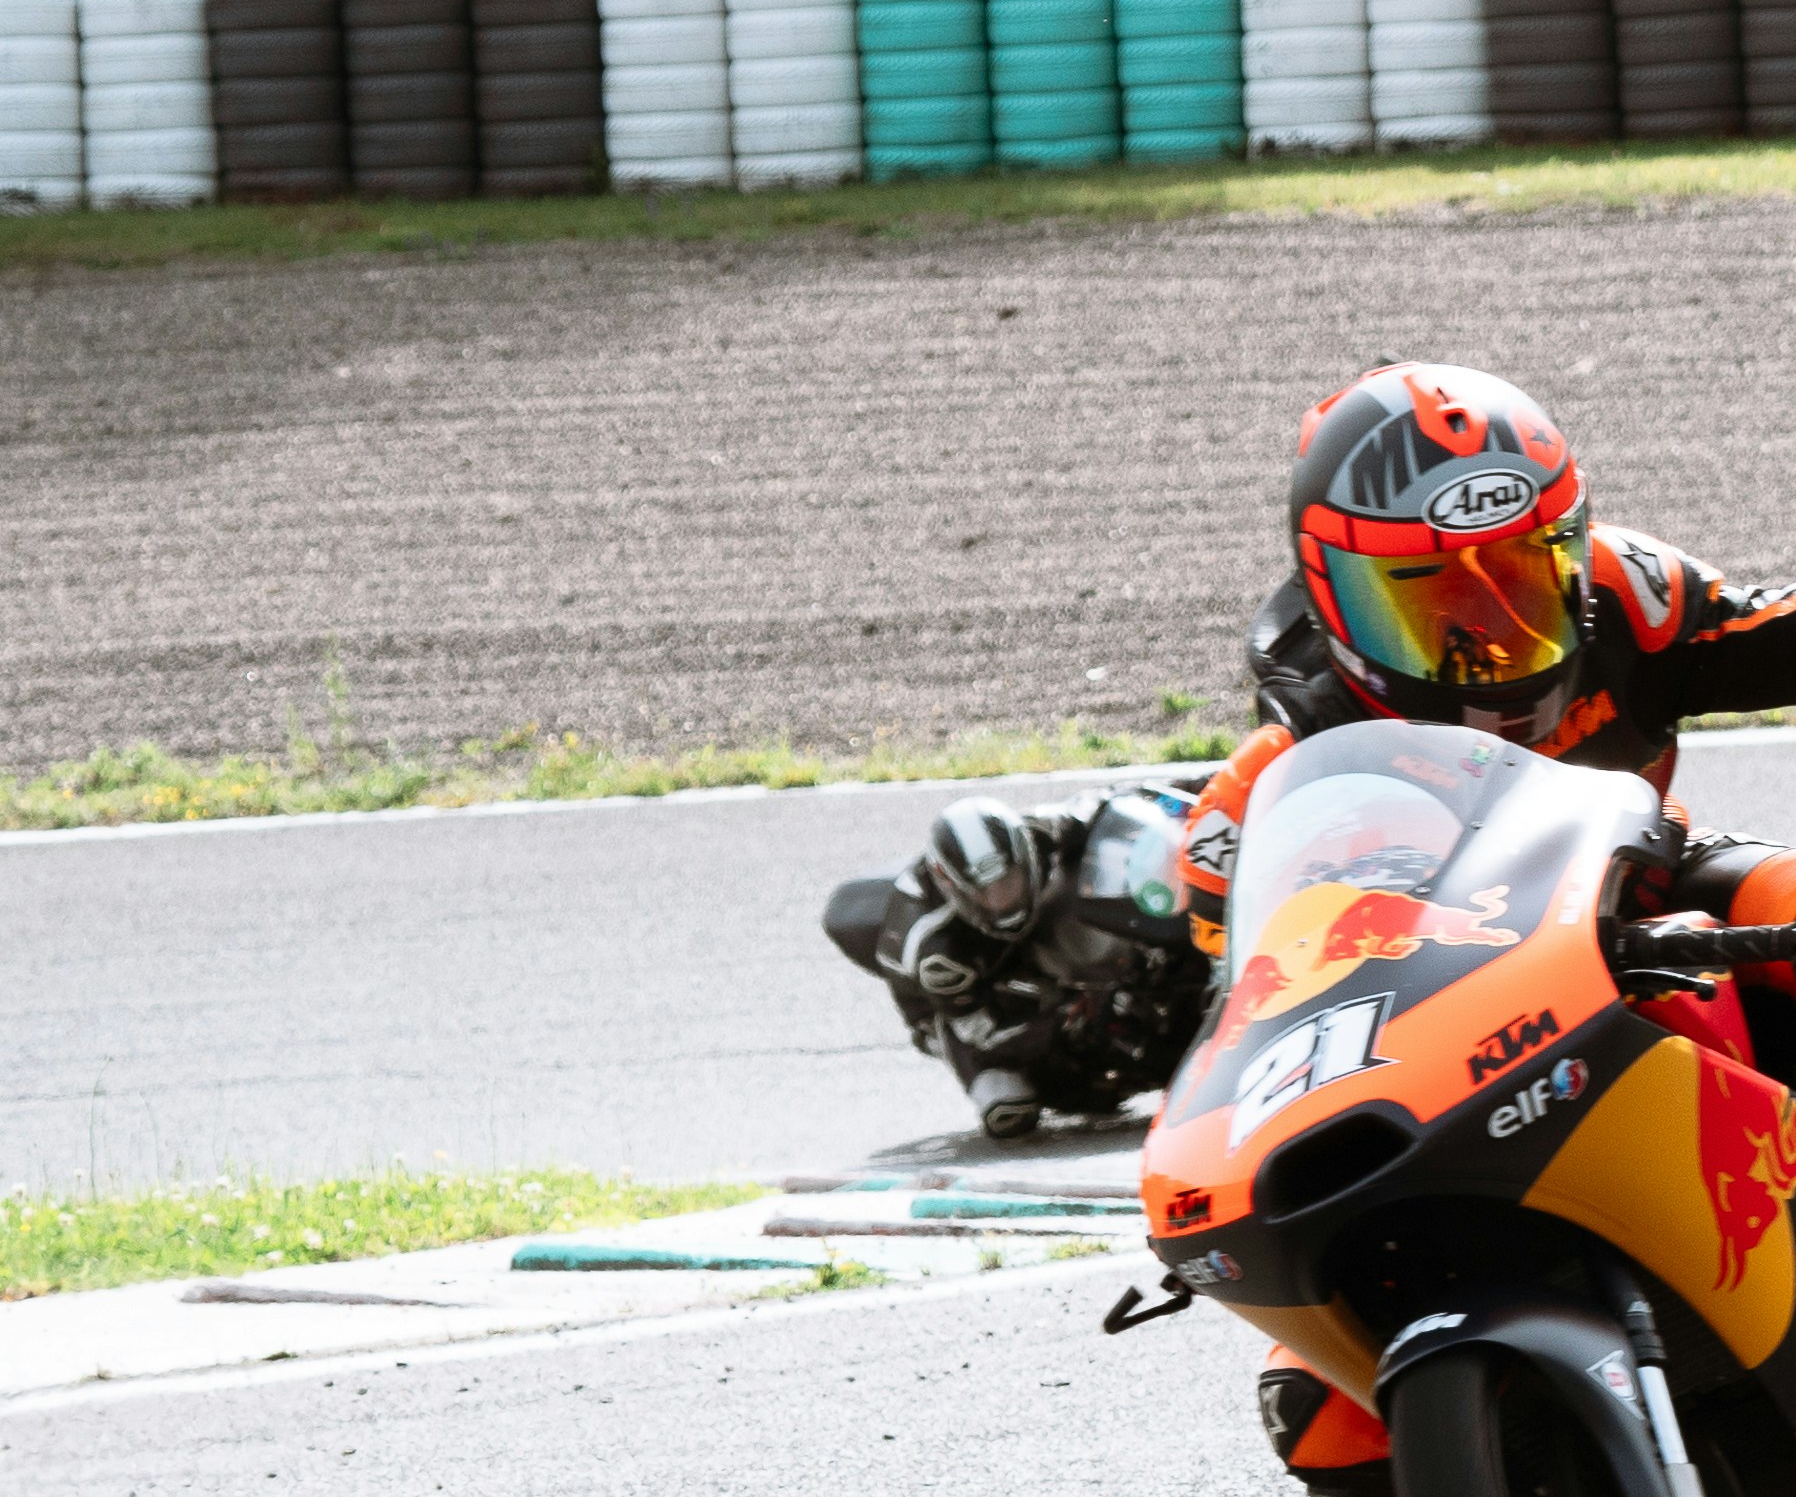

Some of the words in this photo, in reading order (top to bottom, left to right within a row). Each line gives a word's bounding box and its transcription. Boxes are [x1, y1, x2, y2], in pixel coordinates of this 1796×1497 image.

[1447, 480, 1524, 517] Arai
[1227, 993, 1400, 1155] 21
[1465, 1007, 1562, 1076] KTM
[1487, 1076, 1553, 1139] elf
